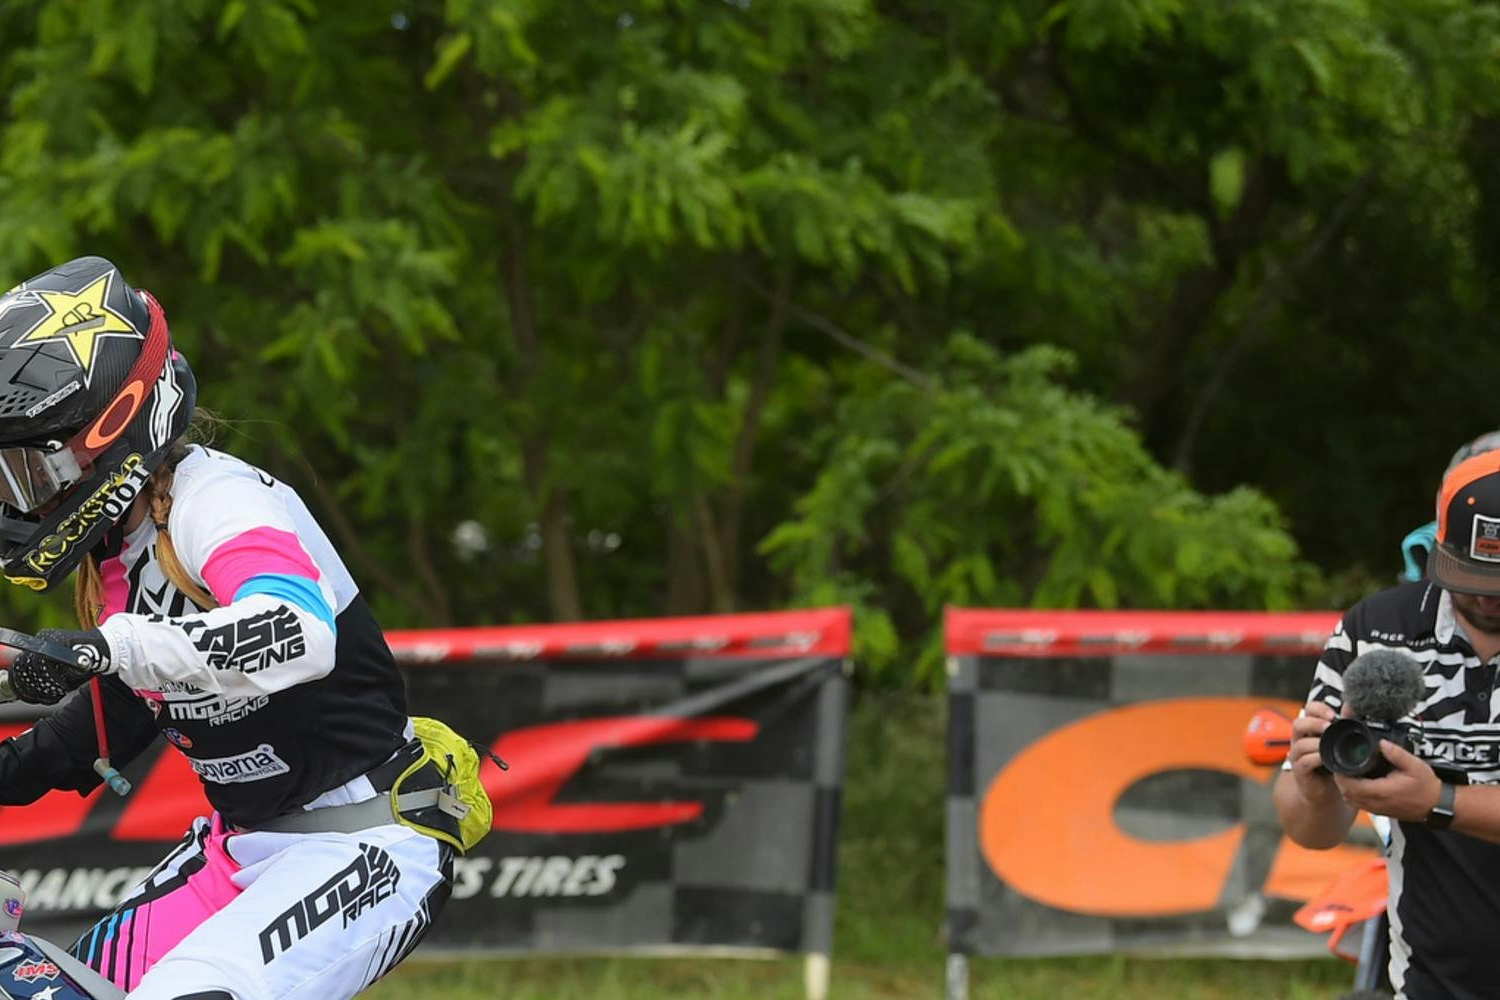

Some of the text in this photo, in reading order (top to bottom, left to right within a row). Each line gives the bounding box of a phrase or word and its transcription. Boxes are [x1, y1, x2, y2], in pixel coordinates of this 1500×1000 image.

[101, 467, 150, 521] 001
[209, 696, 269, 727] RACING
[491, 856, 626, 898] TIRES
